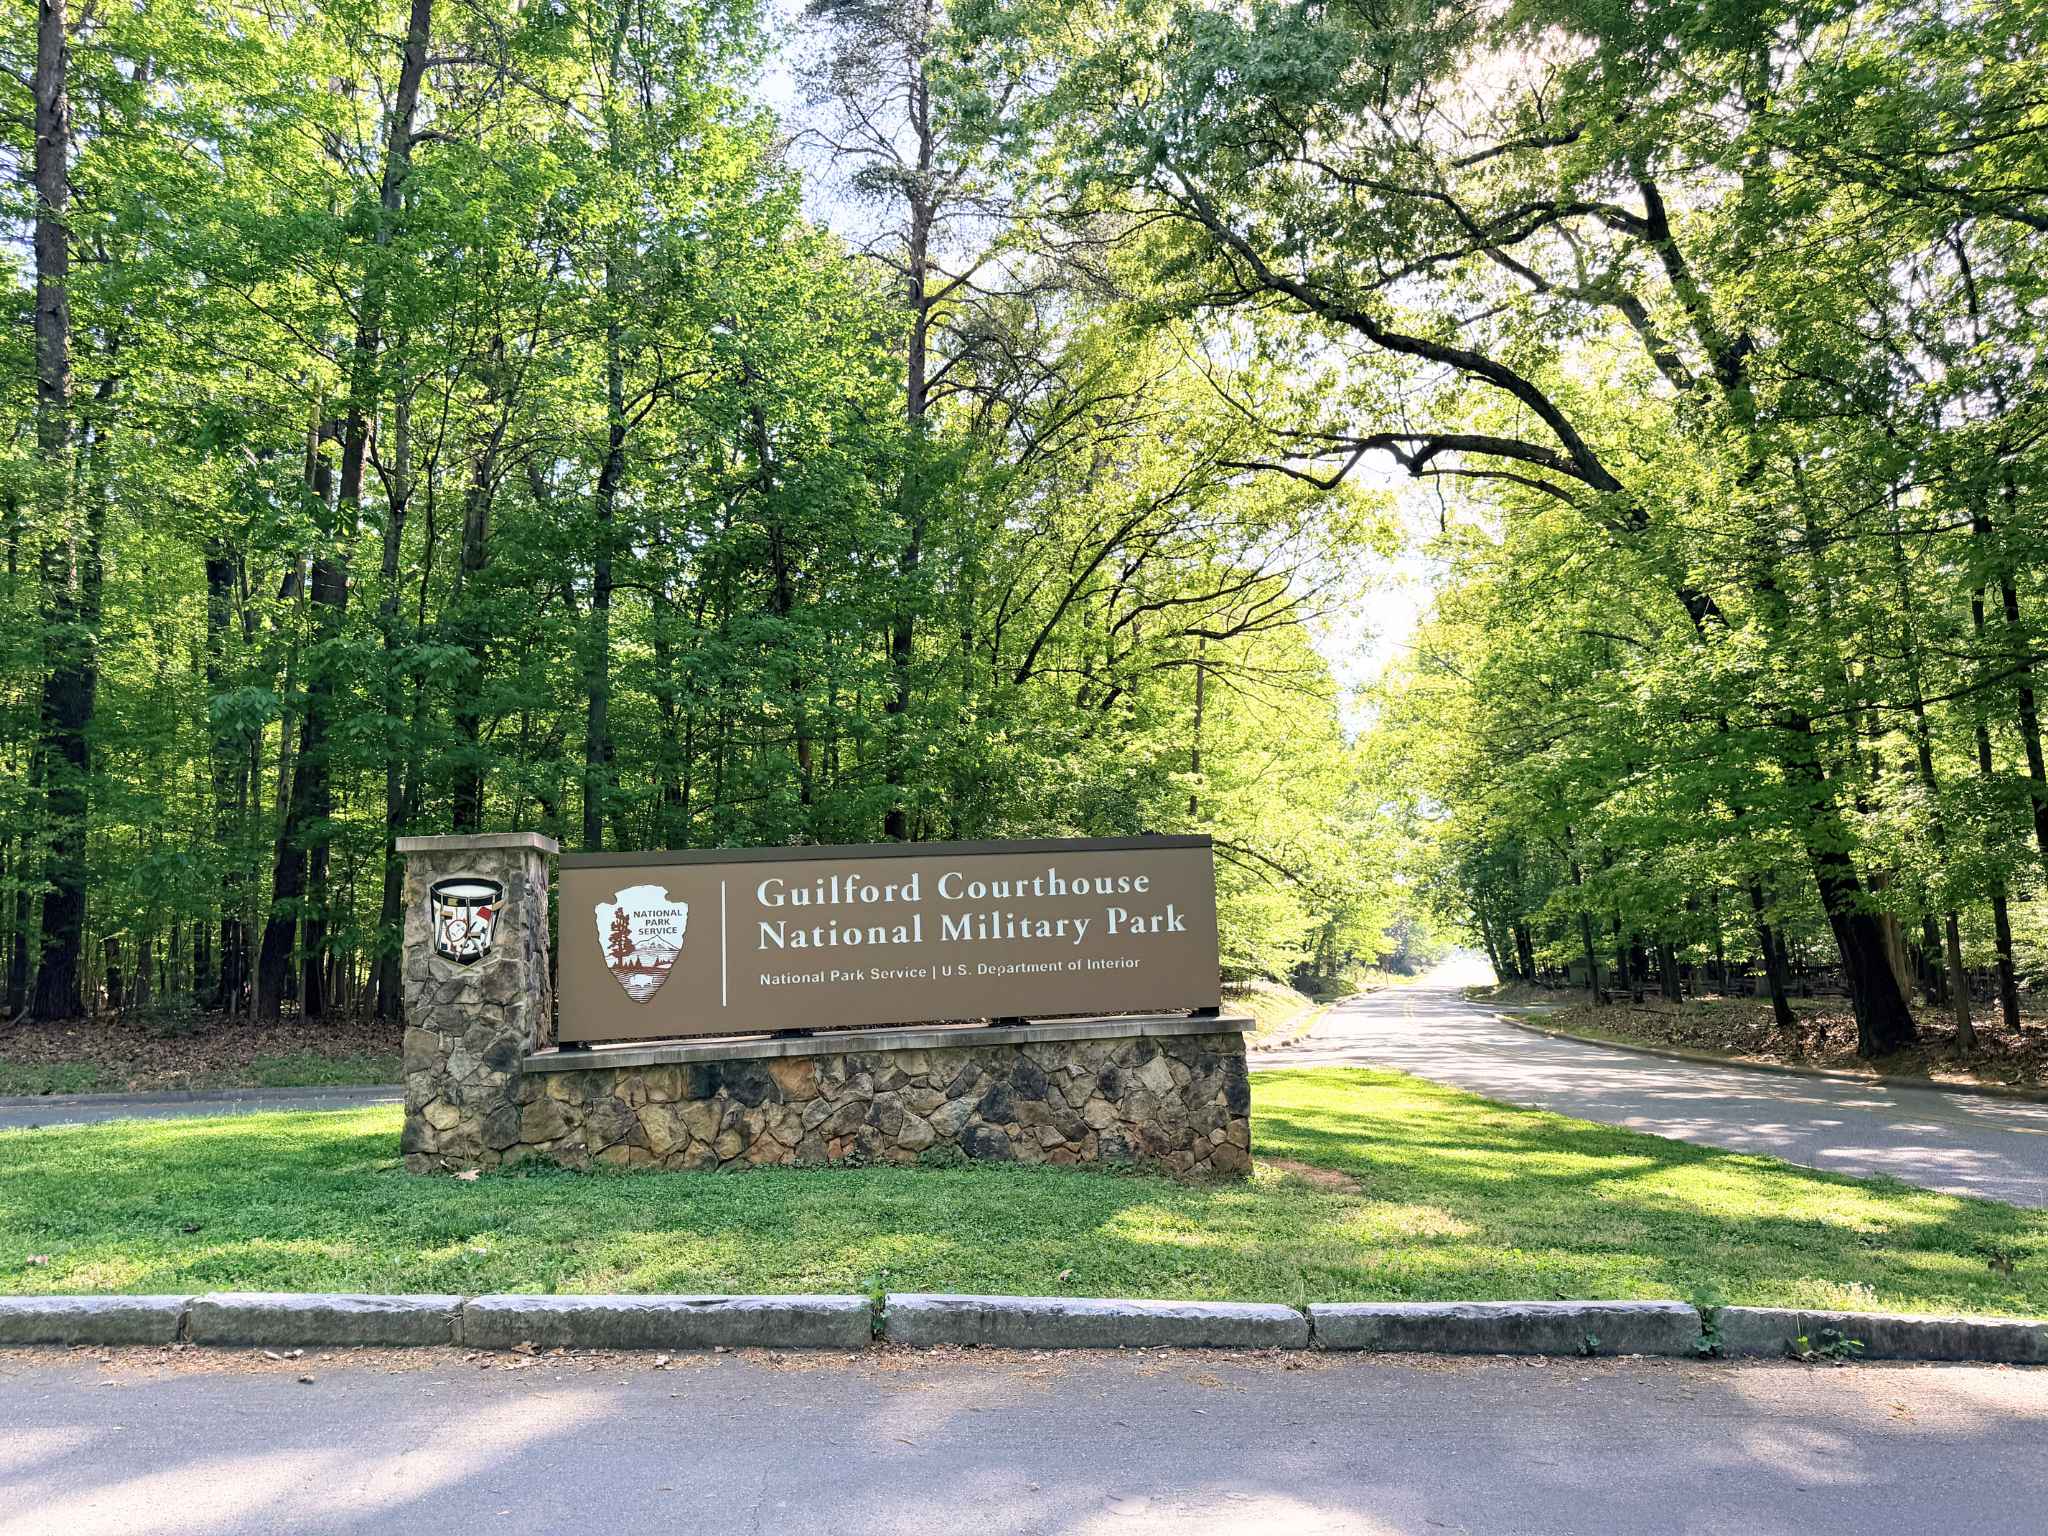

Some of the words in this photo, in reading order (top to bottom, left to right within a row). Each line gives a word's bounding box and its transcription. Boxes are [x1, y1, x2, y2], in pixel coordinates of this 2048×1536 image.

[757, 873, 922, 907] Guilford
[937, 867, 1149, 900] Courthouse
[633, 909, 683, 918] NATIONAL
[645, 918, 670, 926] PARK
[638, 926, 678, 935] SERVICE
[758, 913, 923, 950] National
[941, 910, 1091, 945] Military
[1107, 903, 1186, 935] Park
[760, 970, 825, 985] National
[830, 969, 865, 982] Park
[870, 967, 927, 980] Service
[977, 961, 1062, 976] Department
[1067, 959, 1082, 970] of
[1087, 957, 1141, 970] Interior
